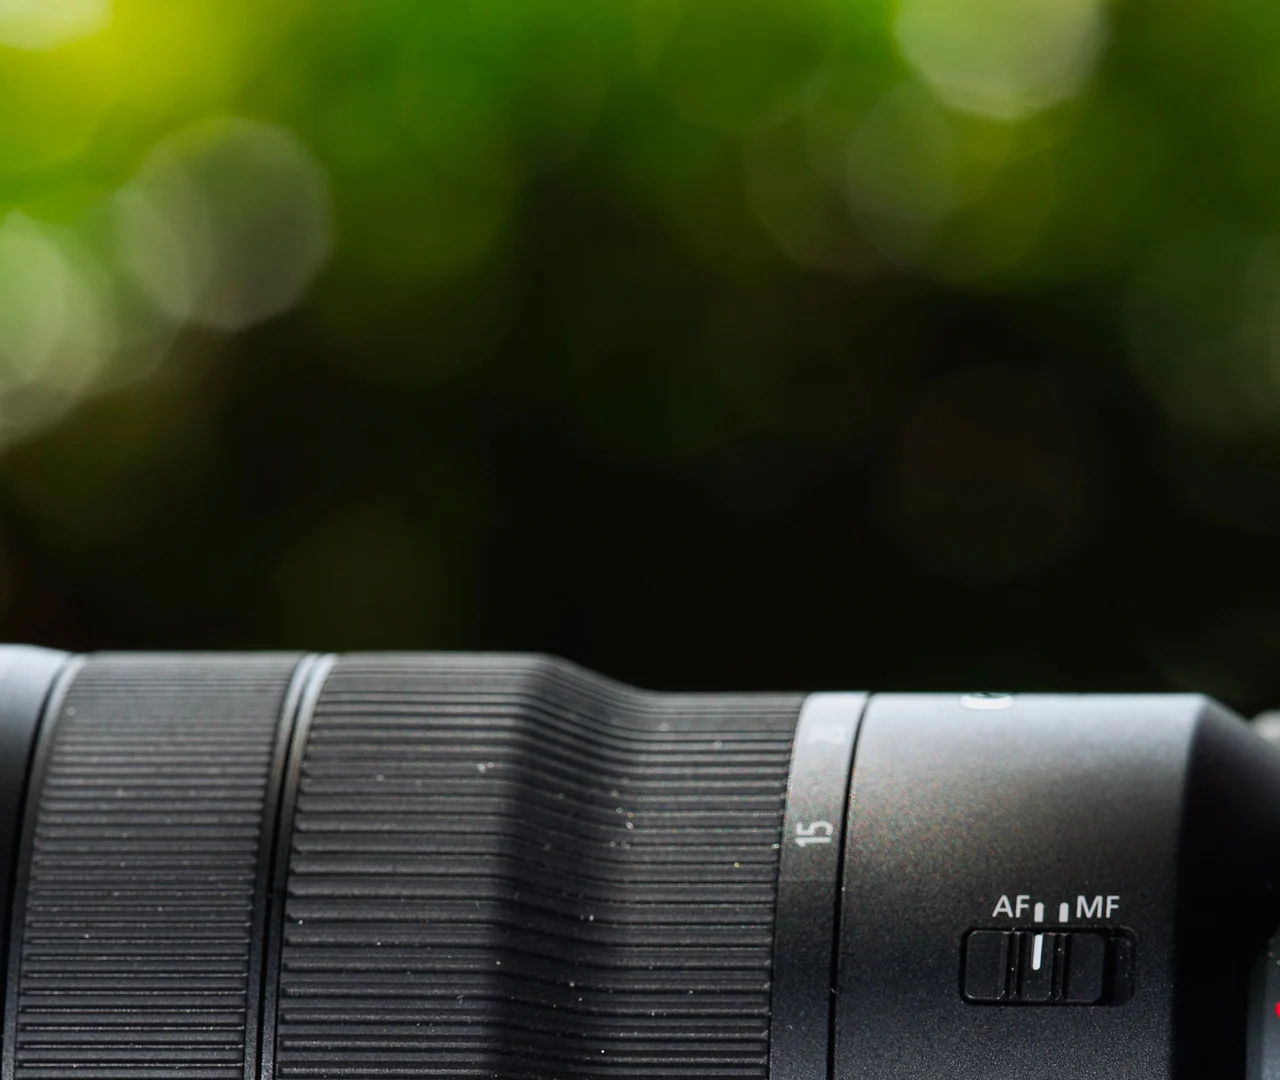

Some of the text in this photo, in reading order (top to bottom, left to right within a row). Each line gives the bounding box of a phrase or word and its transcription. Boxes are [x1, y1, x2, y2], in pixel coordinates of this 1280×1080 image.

[794, 819, 834, 847] 15
[992, 894, 1120, 919] AF MF
